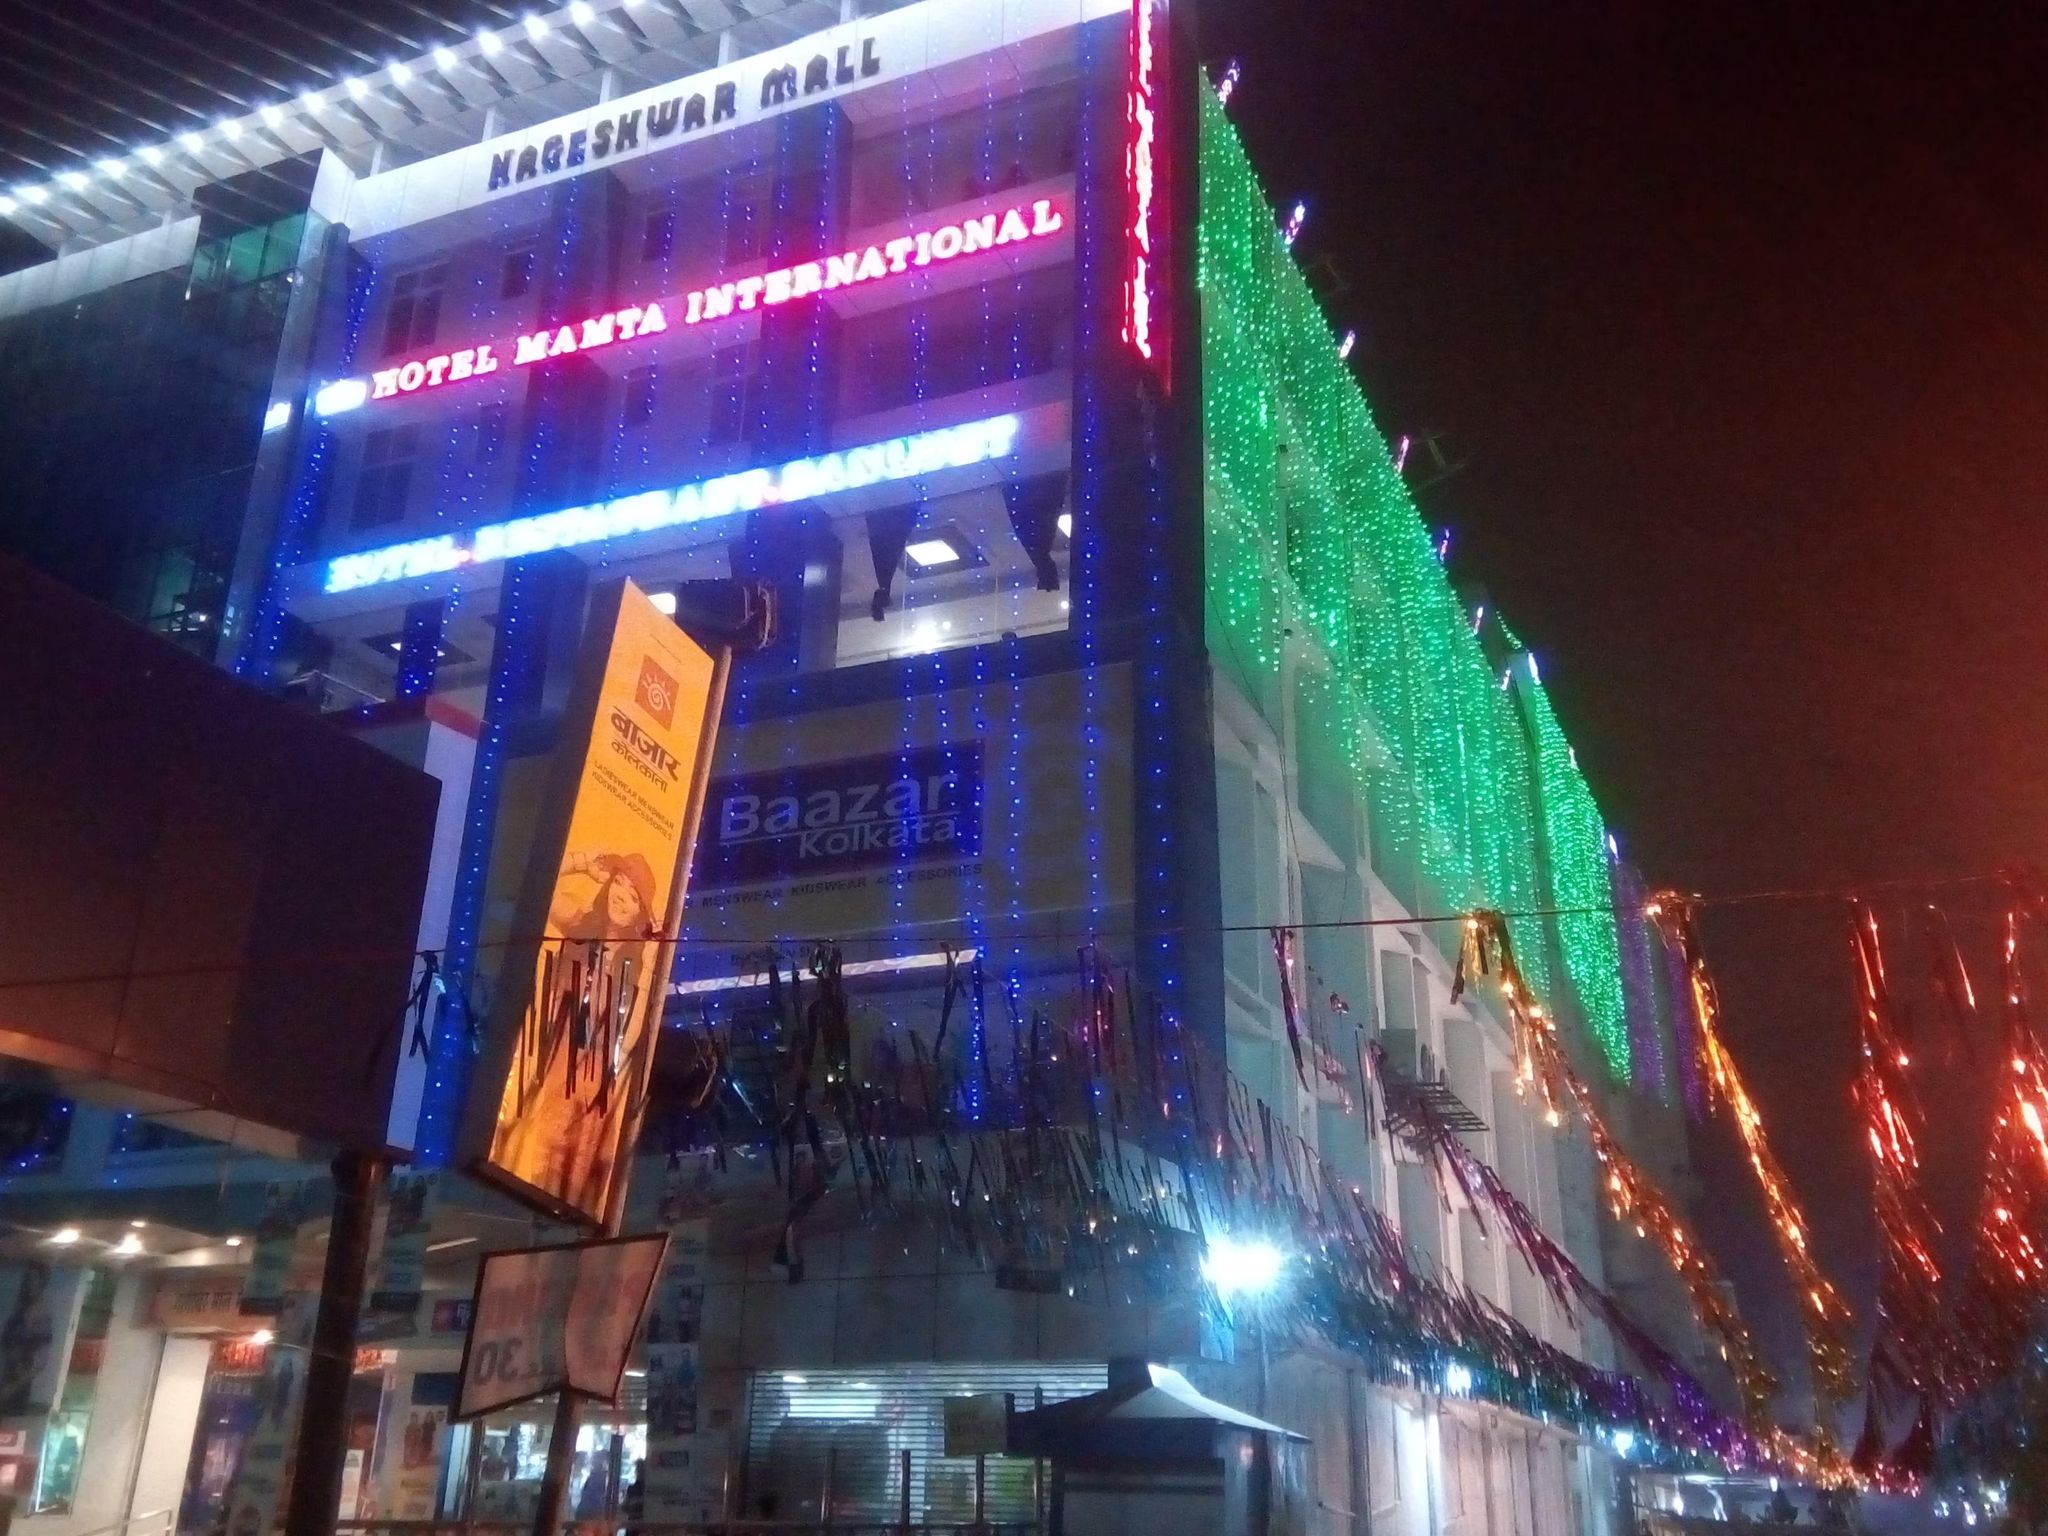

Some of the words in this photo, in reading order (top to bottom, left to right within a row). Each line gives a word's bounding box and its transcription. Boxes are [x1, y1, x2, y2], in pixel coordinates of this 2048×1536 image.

[486, 80, 738, 192] NAGESHWAR
[760, 37, 881, 109] MALL
[371, 345, 498, 399] HOTEL
[513, 302, 667, 366] MAMTA
[684, 199, 1062, 324] INTERNATIONAL
[611, 705, 682, 783] बाजार
[611, 738, 668, 794] कोलकाता
[719, 773, 959, 841] Baazar
[799, 817, 956, 862] Kolkata
